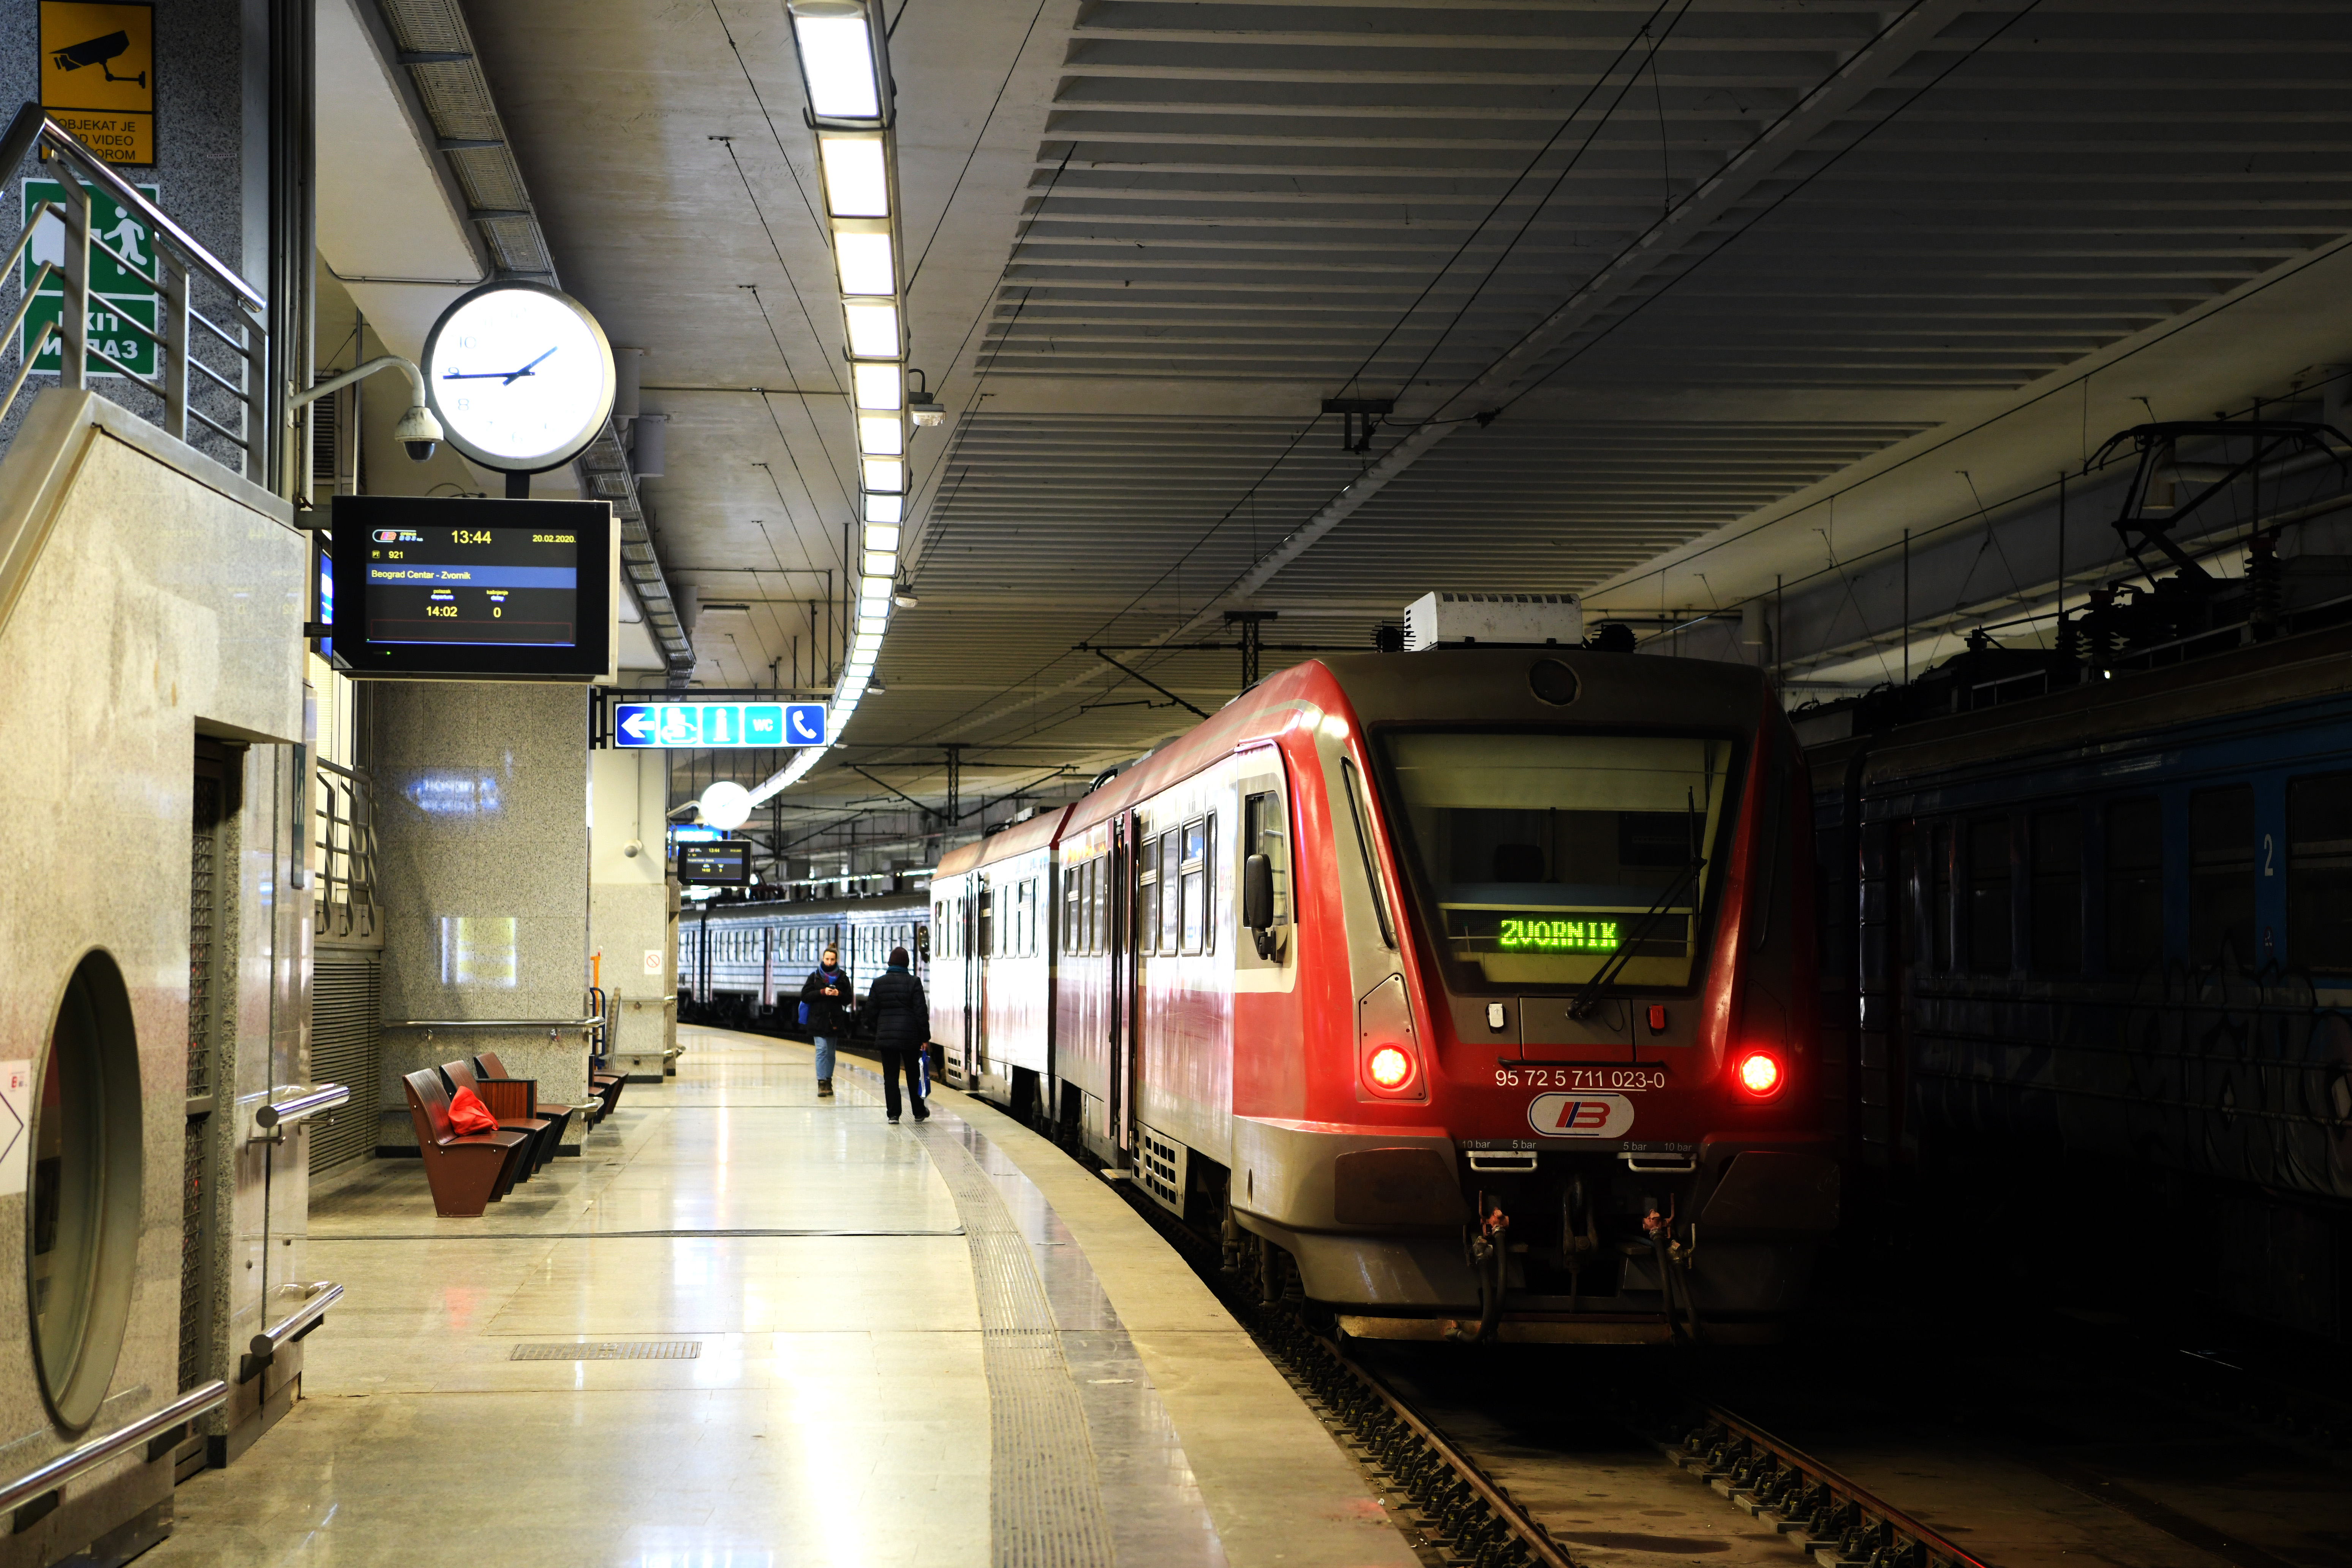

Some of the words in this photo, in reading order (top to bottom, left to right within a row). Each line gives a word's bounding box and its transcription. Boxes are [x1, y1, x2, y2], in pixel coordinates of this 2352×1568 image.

[58, 119, 117, 131] OBJEKAT
[121, 122, 135, 132] JE
[93, 134, 133, 146] VIDEO
[58, 311, 118, 332] IT
[43, 337, 138, 359] ИАЗ
[460, 336, 476, 349] 10
[458, 398, 469, 411] 8
[452, 530, 492, 544] 13:44
[533, 534, 576, 543] 20.02.2020.
[371, 570, 405, 580] Beograd
[441, 571, 471, 579] Zvornik
[426, 606, 458, 617] 14:02
[493, 607, 501, 618] 0
[753, 719, 773, 732] WC
[2264, 833, 2273, 876] 2
[1501, 920, 1616, 947] ZVORNIK
[1495, 1070, 1519, 1086] 95
[1525, 1070, 1548, 1086] 72
[1555, 1070, 1566, 1086] 5
[1572, 1070, 1603, 1087] 711
[1612, 1071, 1665, 1088] 023-0
[1462, 1140, 1473, 1149] 10
[1476, 1140, 1490, 1149] bar
[1512, 1140, 1518, 1149] 5
[1521, 1140, 1536, 1149] bar
[1623, 1142, 1629, 1151] 5
[1632, 1142, 1647, 1151] bar
[1664, 1143, 1674, 1151] 10
[1677, 1143, 1692, 1151] bar
